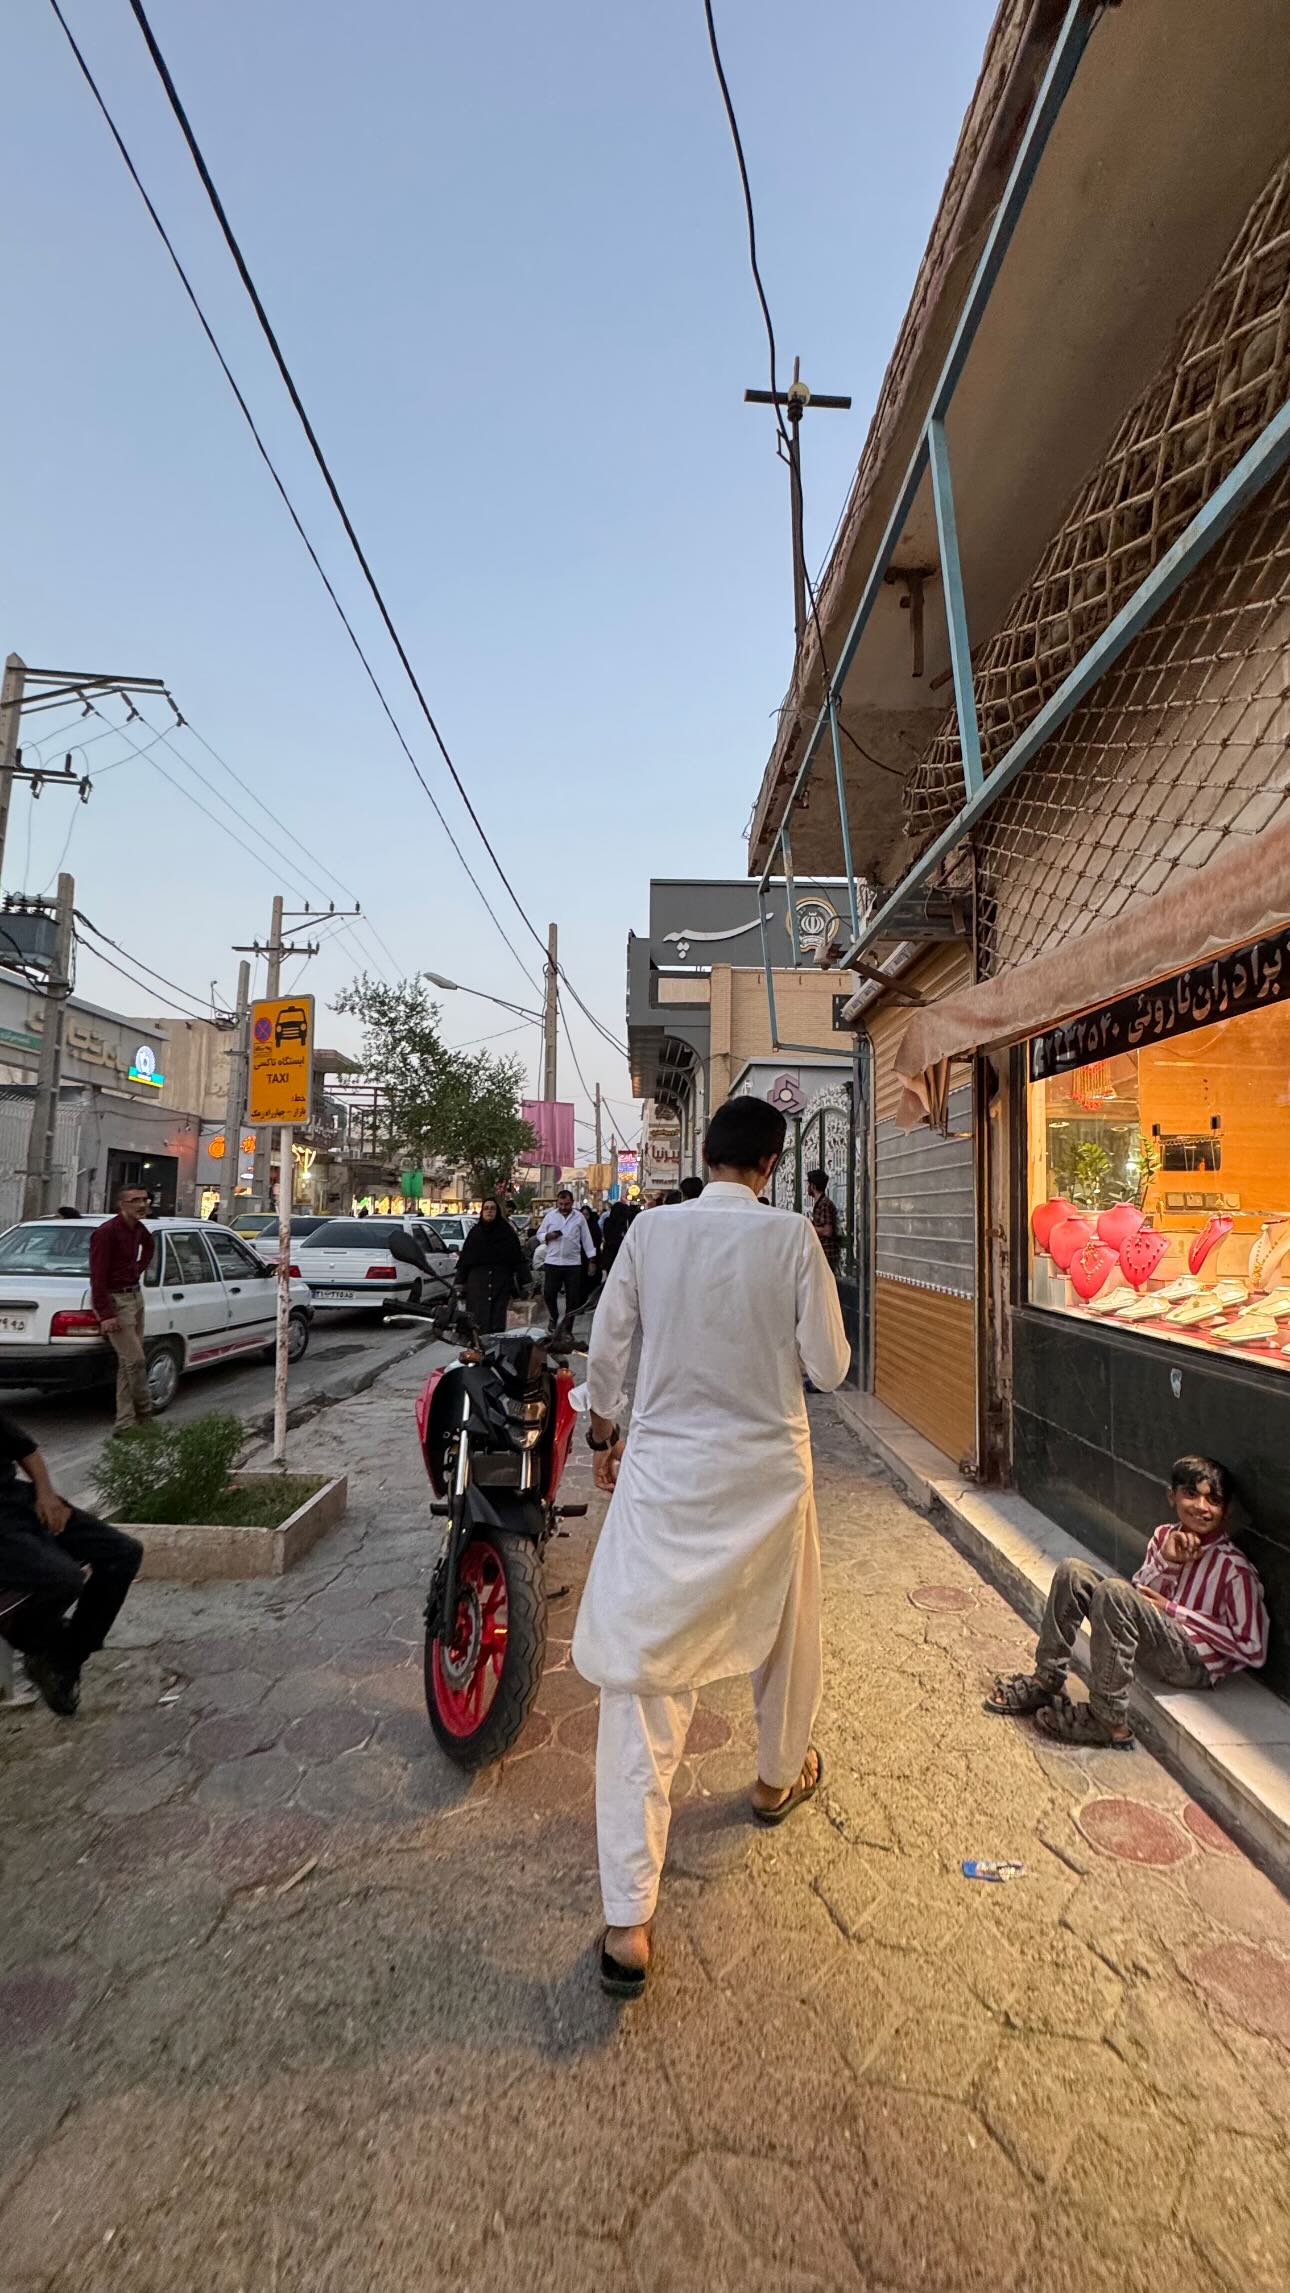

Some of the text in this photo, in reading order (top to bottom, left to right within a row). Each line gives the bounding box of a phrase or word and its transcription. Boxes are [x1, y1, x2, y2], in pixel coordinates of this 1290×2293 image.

[1192, 945, 1282, 1021] برادران
[253, 1058, 277, 1070] تاکسی
[278, 1056, 304, 1068] ایستگاه
[266, 1073, 289, 1084] TAXI
[293, 1107, 306, 1118] بازار
